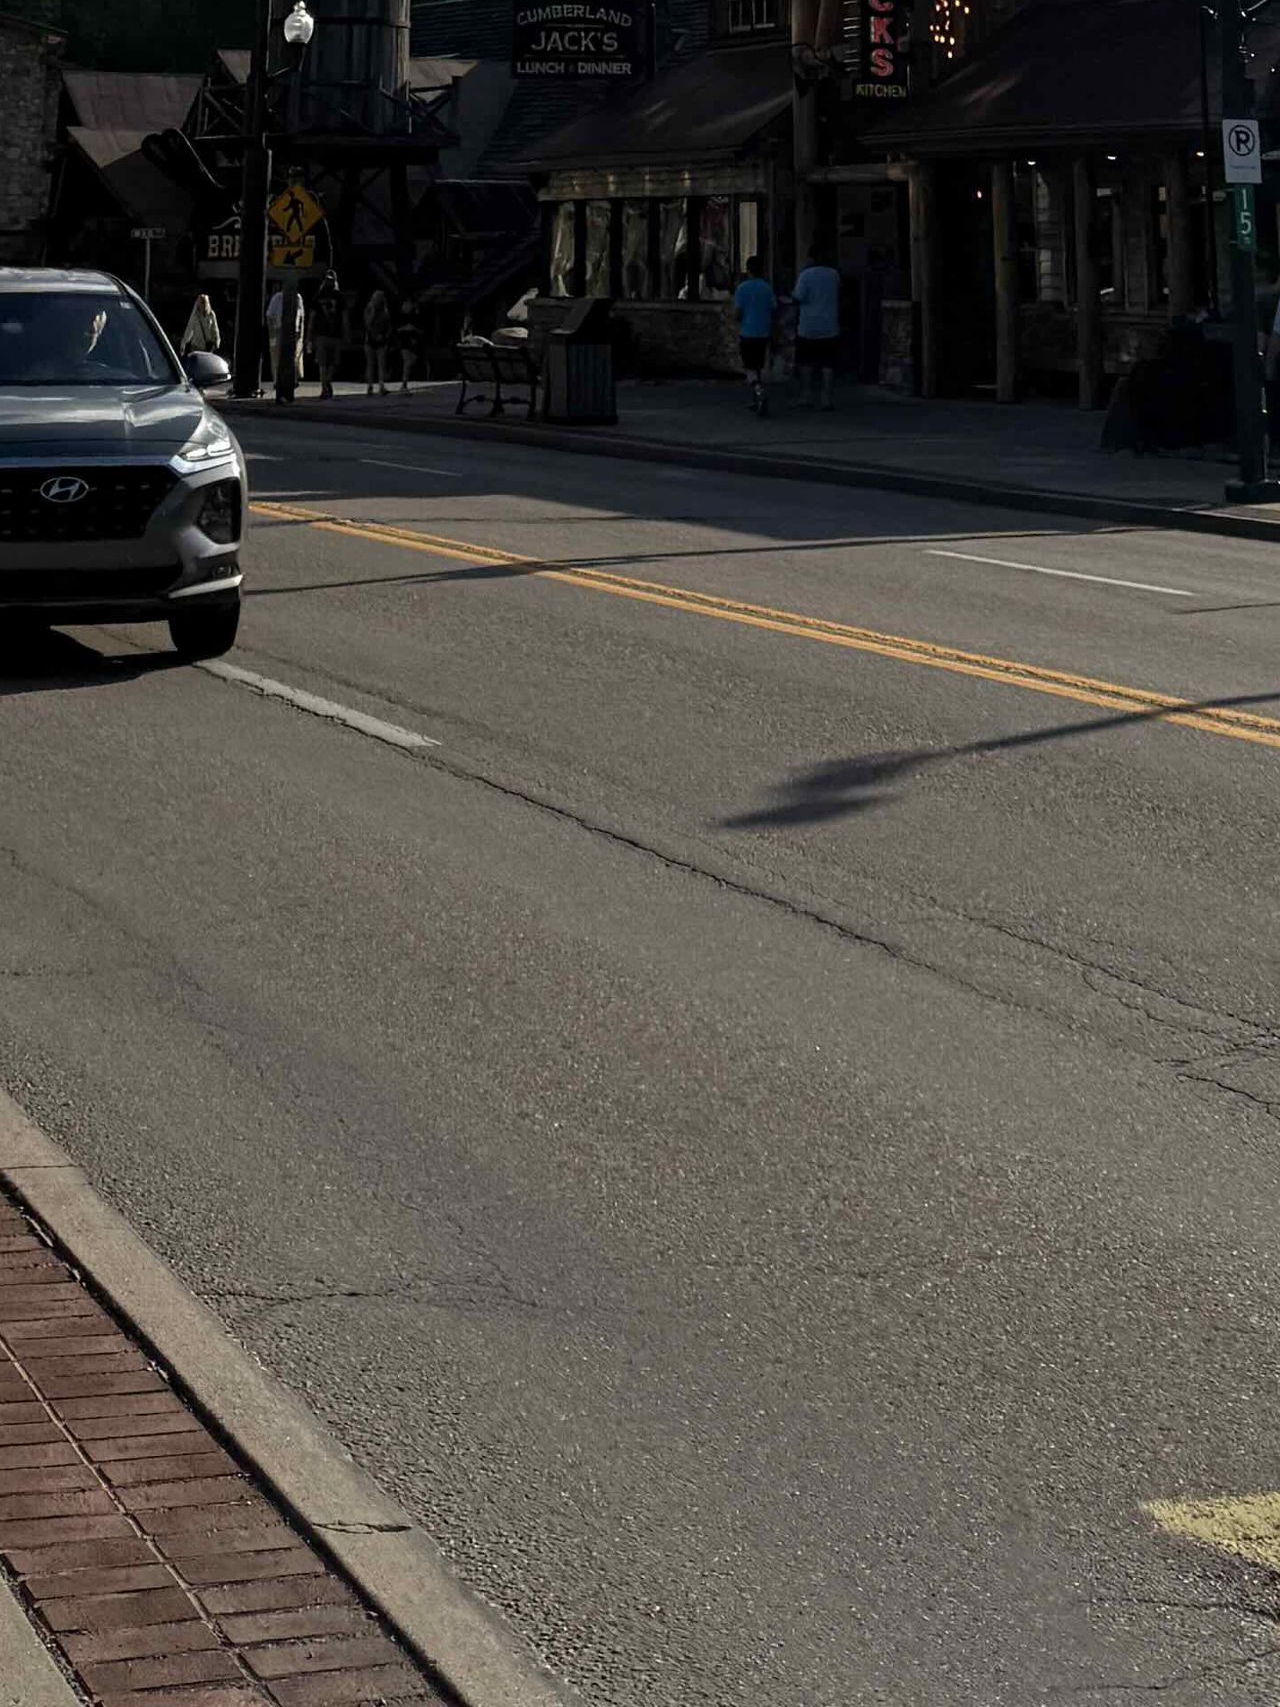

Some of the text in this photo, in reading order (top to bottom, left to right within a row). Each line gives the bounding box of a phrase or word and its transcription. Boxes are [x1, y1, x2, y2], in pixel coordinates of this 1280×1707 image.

[516, 4, 633, 28] CUMBERLAND
[530, 31, 620, 52] JACK'S
[516, 61, 566, 75] LUNCH
[577, 61, 633, 75] DINNER
[855, 83, 908, 99] KITCHEN
